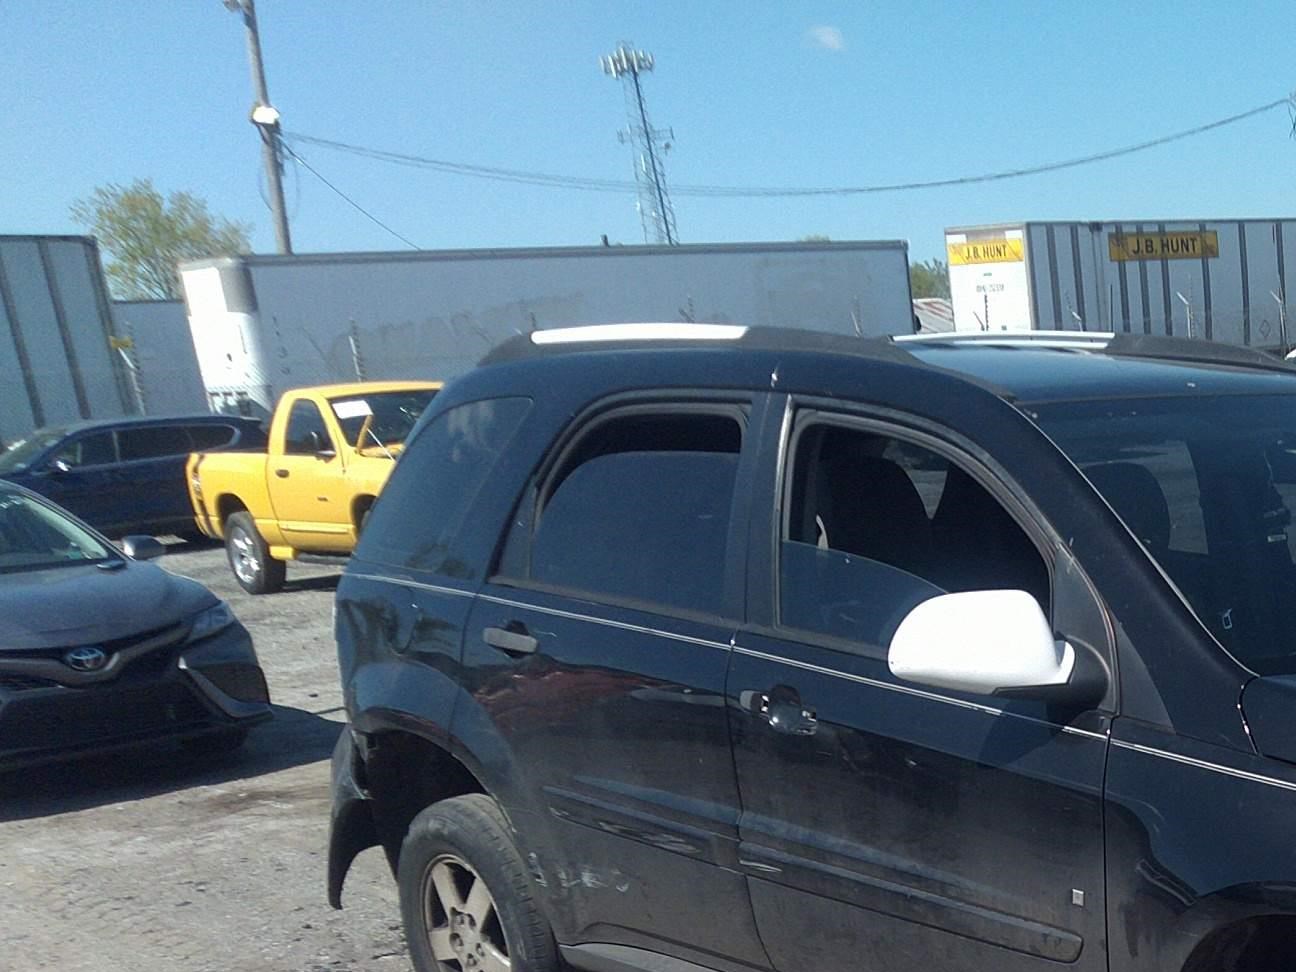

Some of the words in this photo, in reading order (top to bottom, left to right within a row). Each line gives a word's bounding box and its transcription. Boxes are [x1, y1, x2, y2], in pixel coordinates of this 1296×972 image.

[983, 244, 1007, 258] HUNT
[1131, 237, 1158, 255] J.B.
[1161, 237, 1198, 254] HUNT
